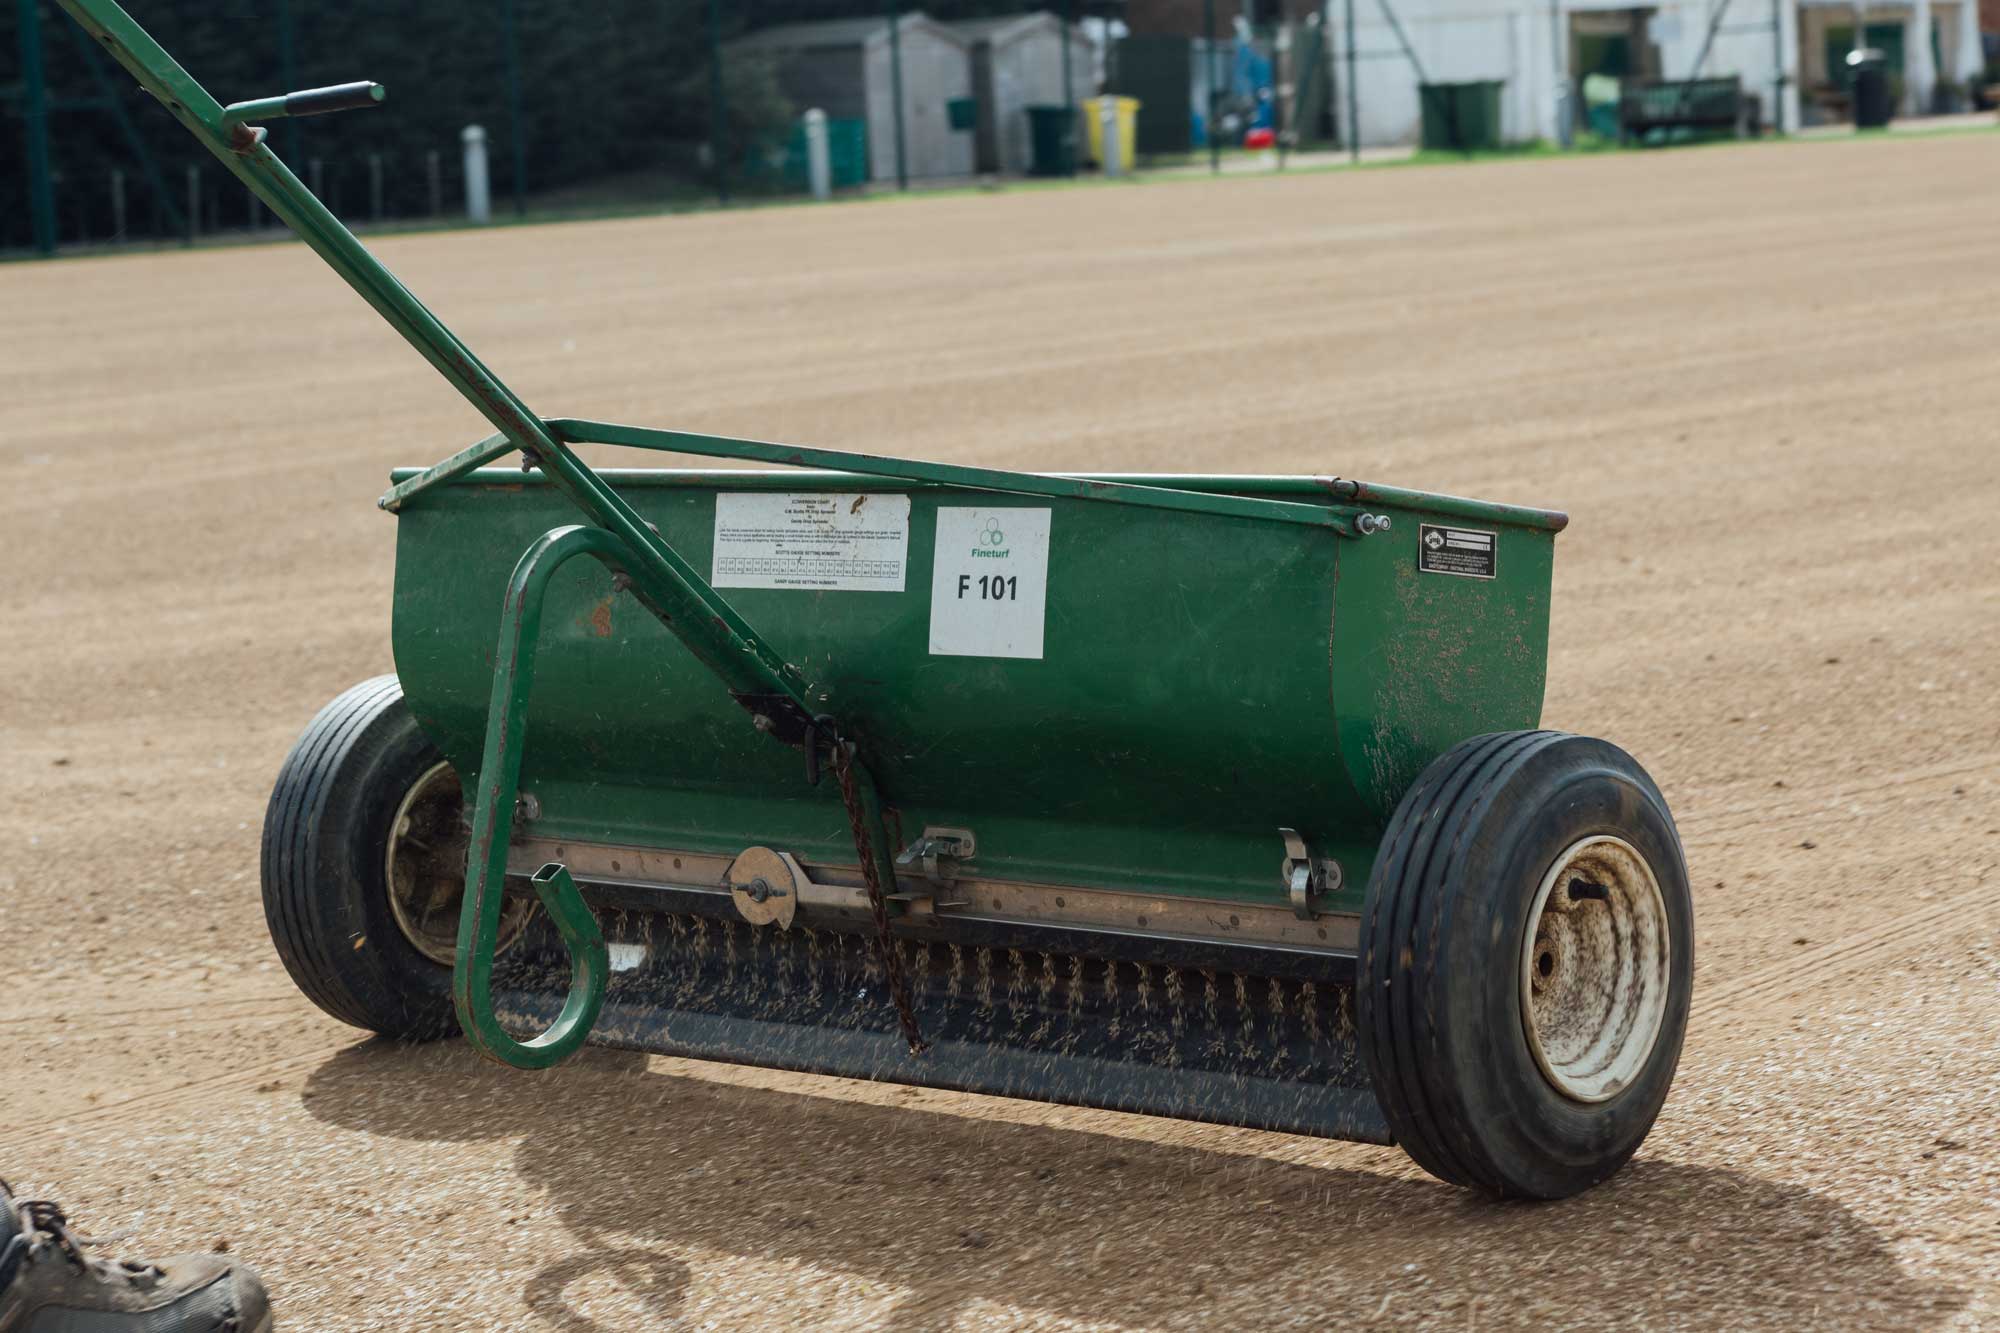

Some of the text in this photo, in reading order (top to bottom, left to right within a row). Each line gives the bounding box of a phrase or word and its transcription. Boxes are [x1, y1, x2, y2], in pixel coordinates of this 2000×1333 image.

[971, 548, 1009, 558] Fineturf
[958, 575, 1017, 600] F 101
